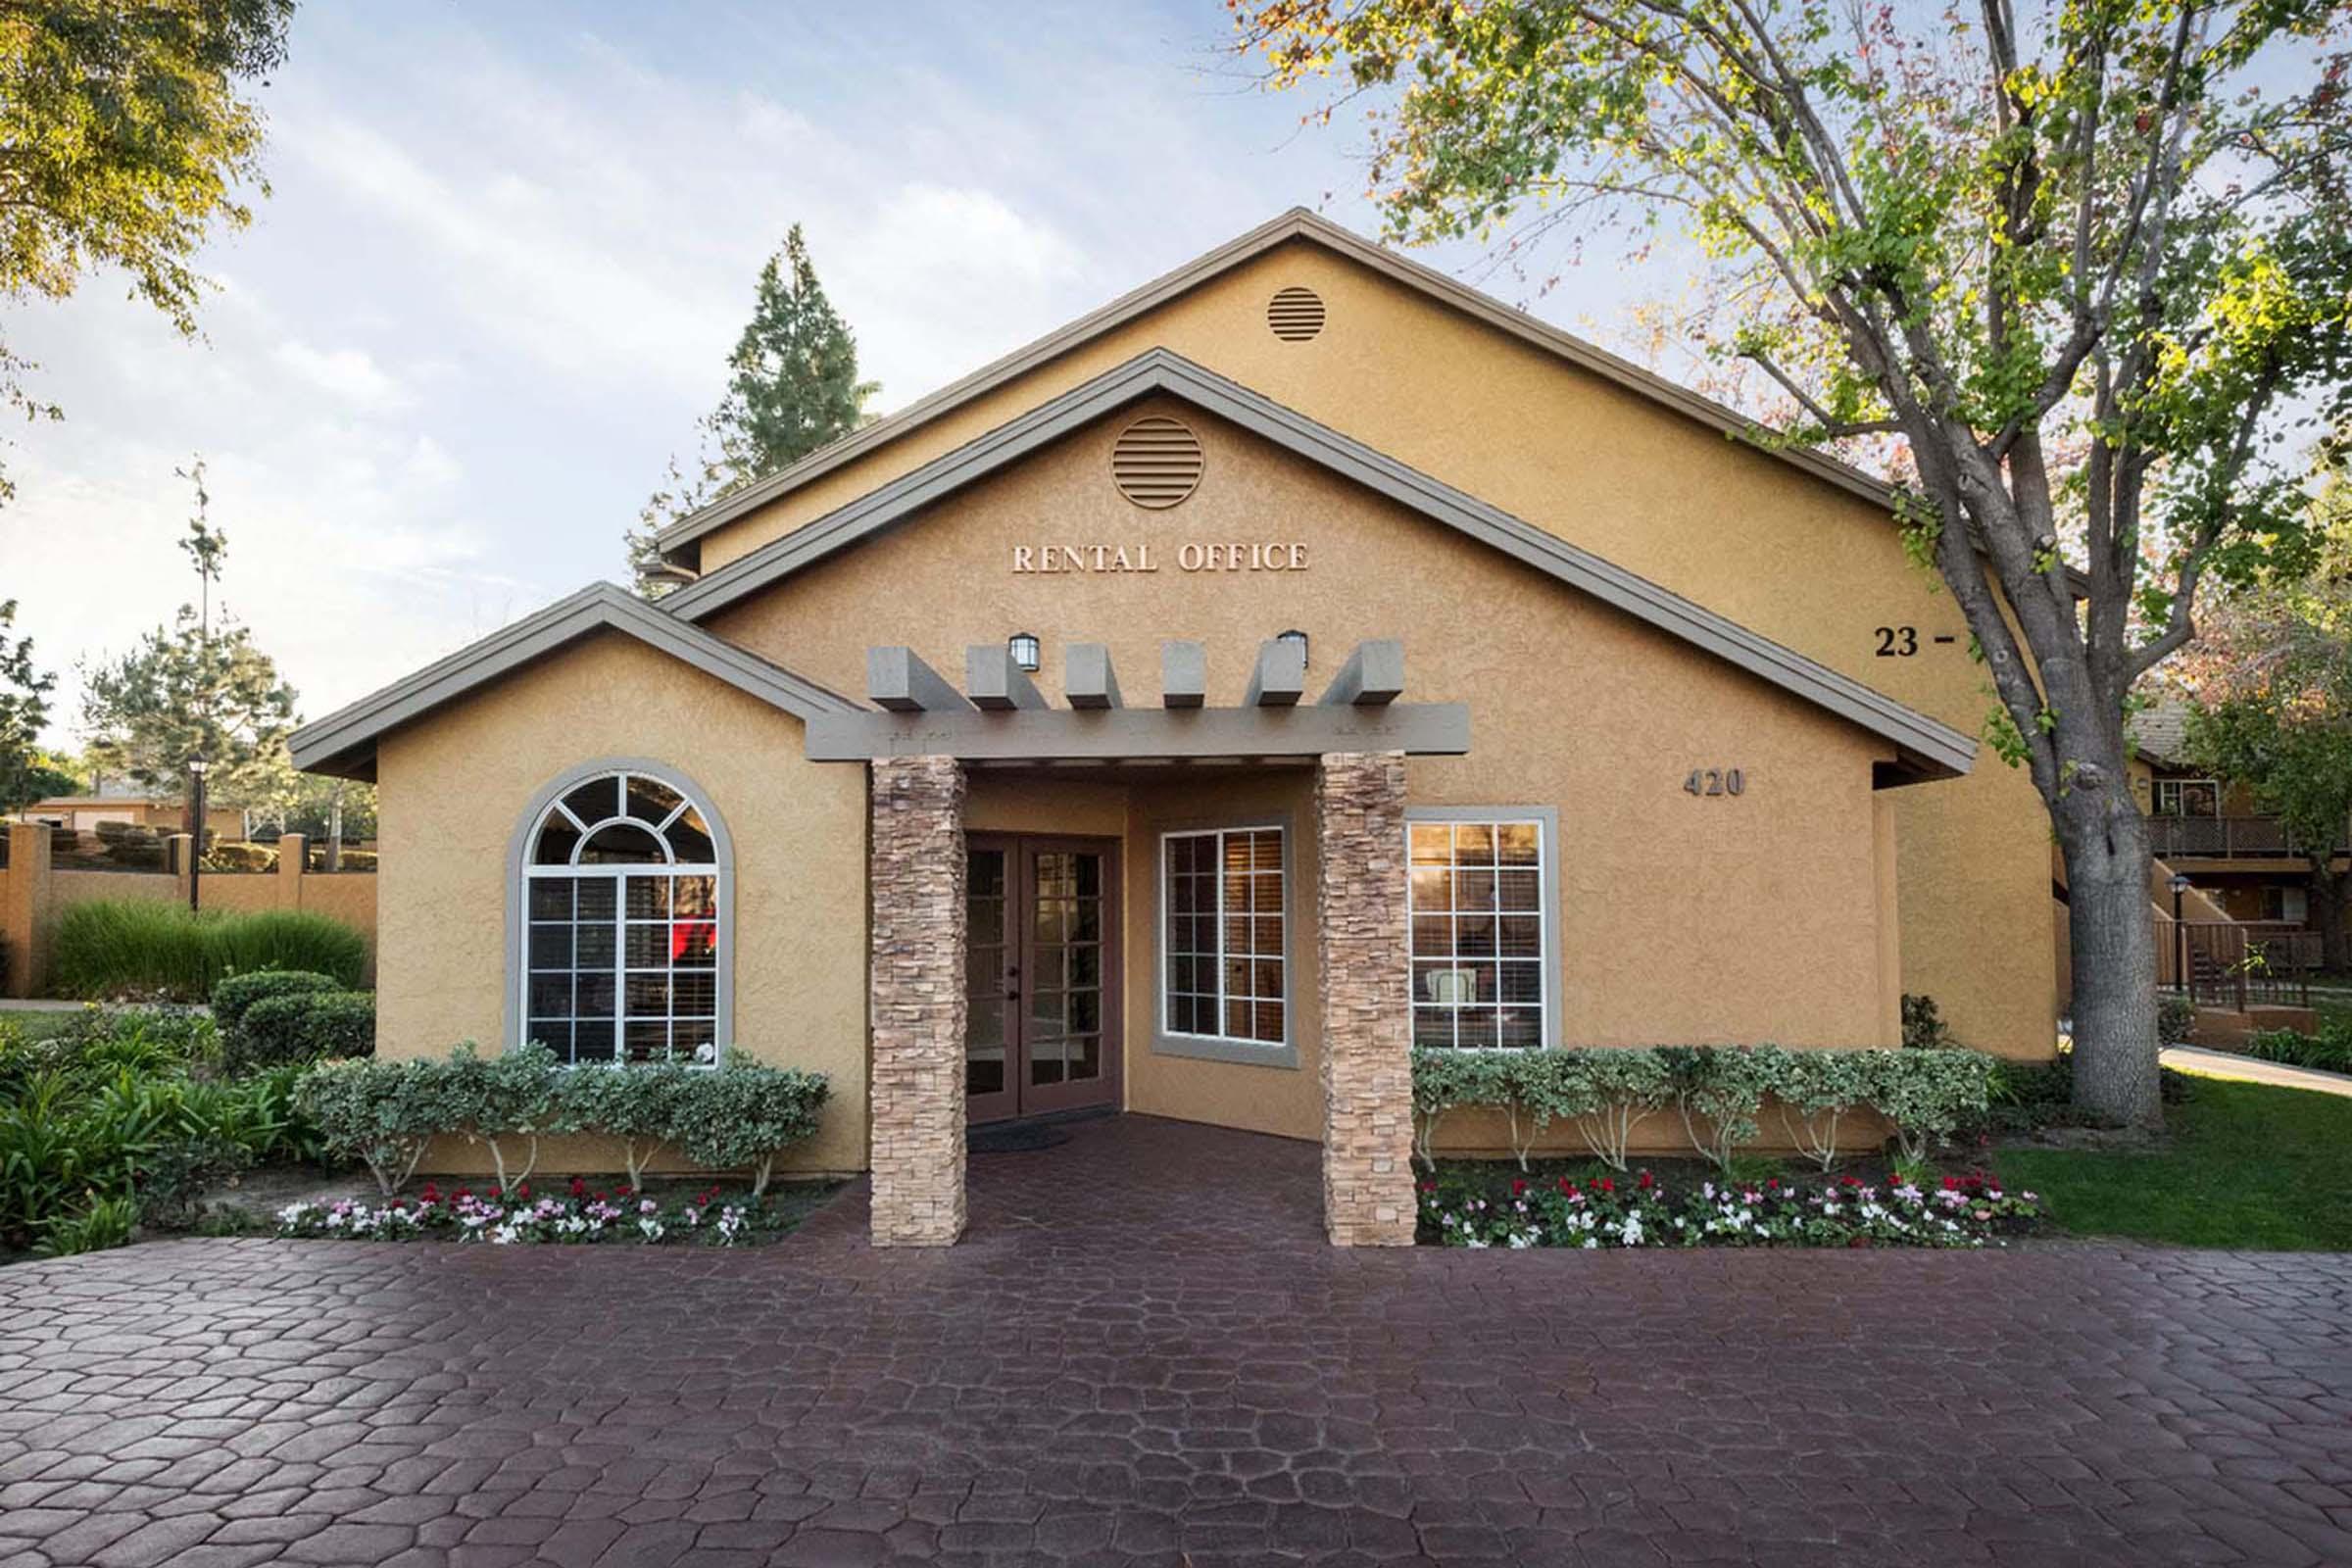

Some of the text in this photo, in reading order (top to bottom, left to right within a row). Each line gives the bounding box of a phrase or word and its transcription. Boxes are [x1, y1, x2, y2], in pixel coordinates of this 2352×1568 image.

[1012, 543, 1309, 573] RENTAL OFFICE
[1684, 768, 1744, 796] 420
